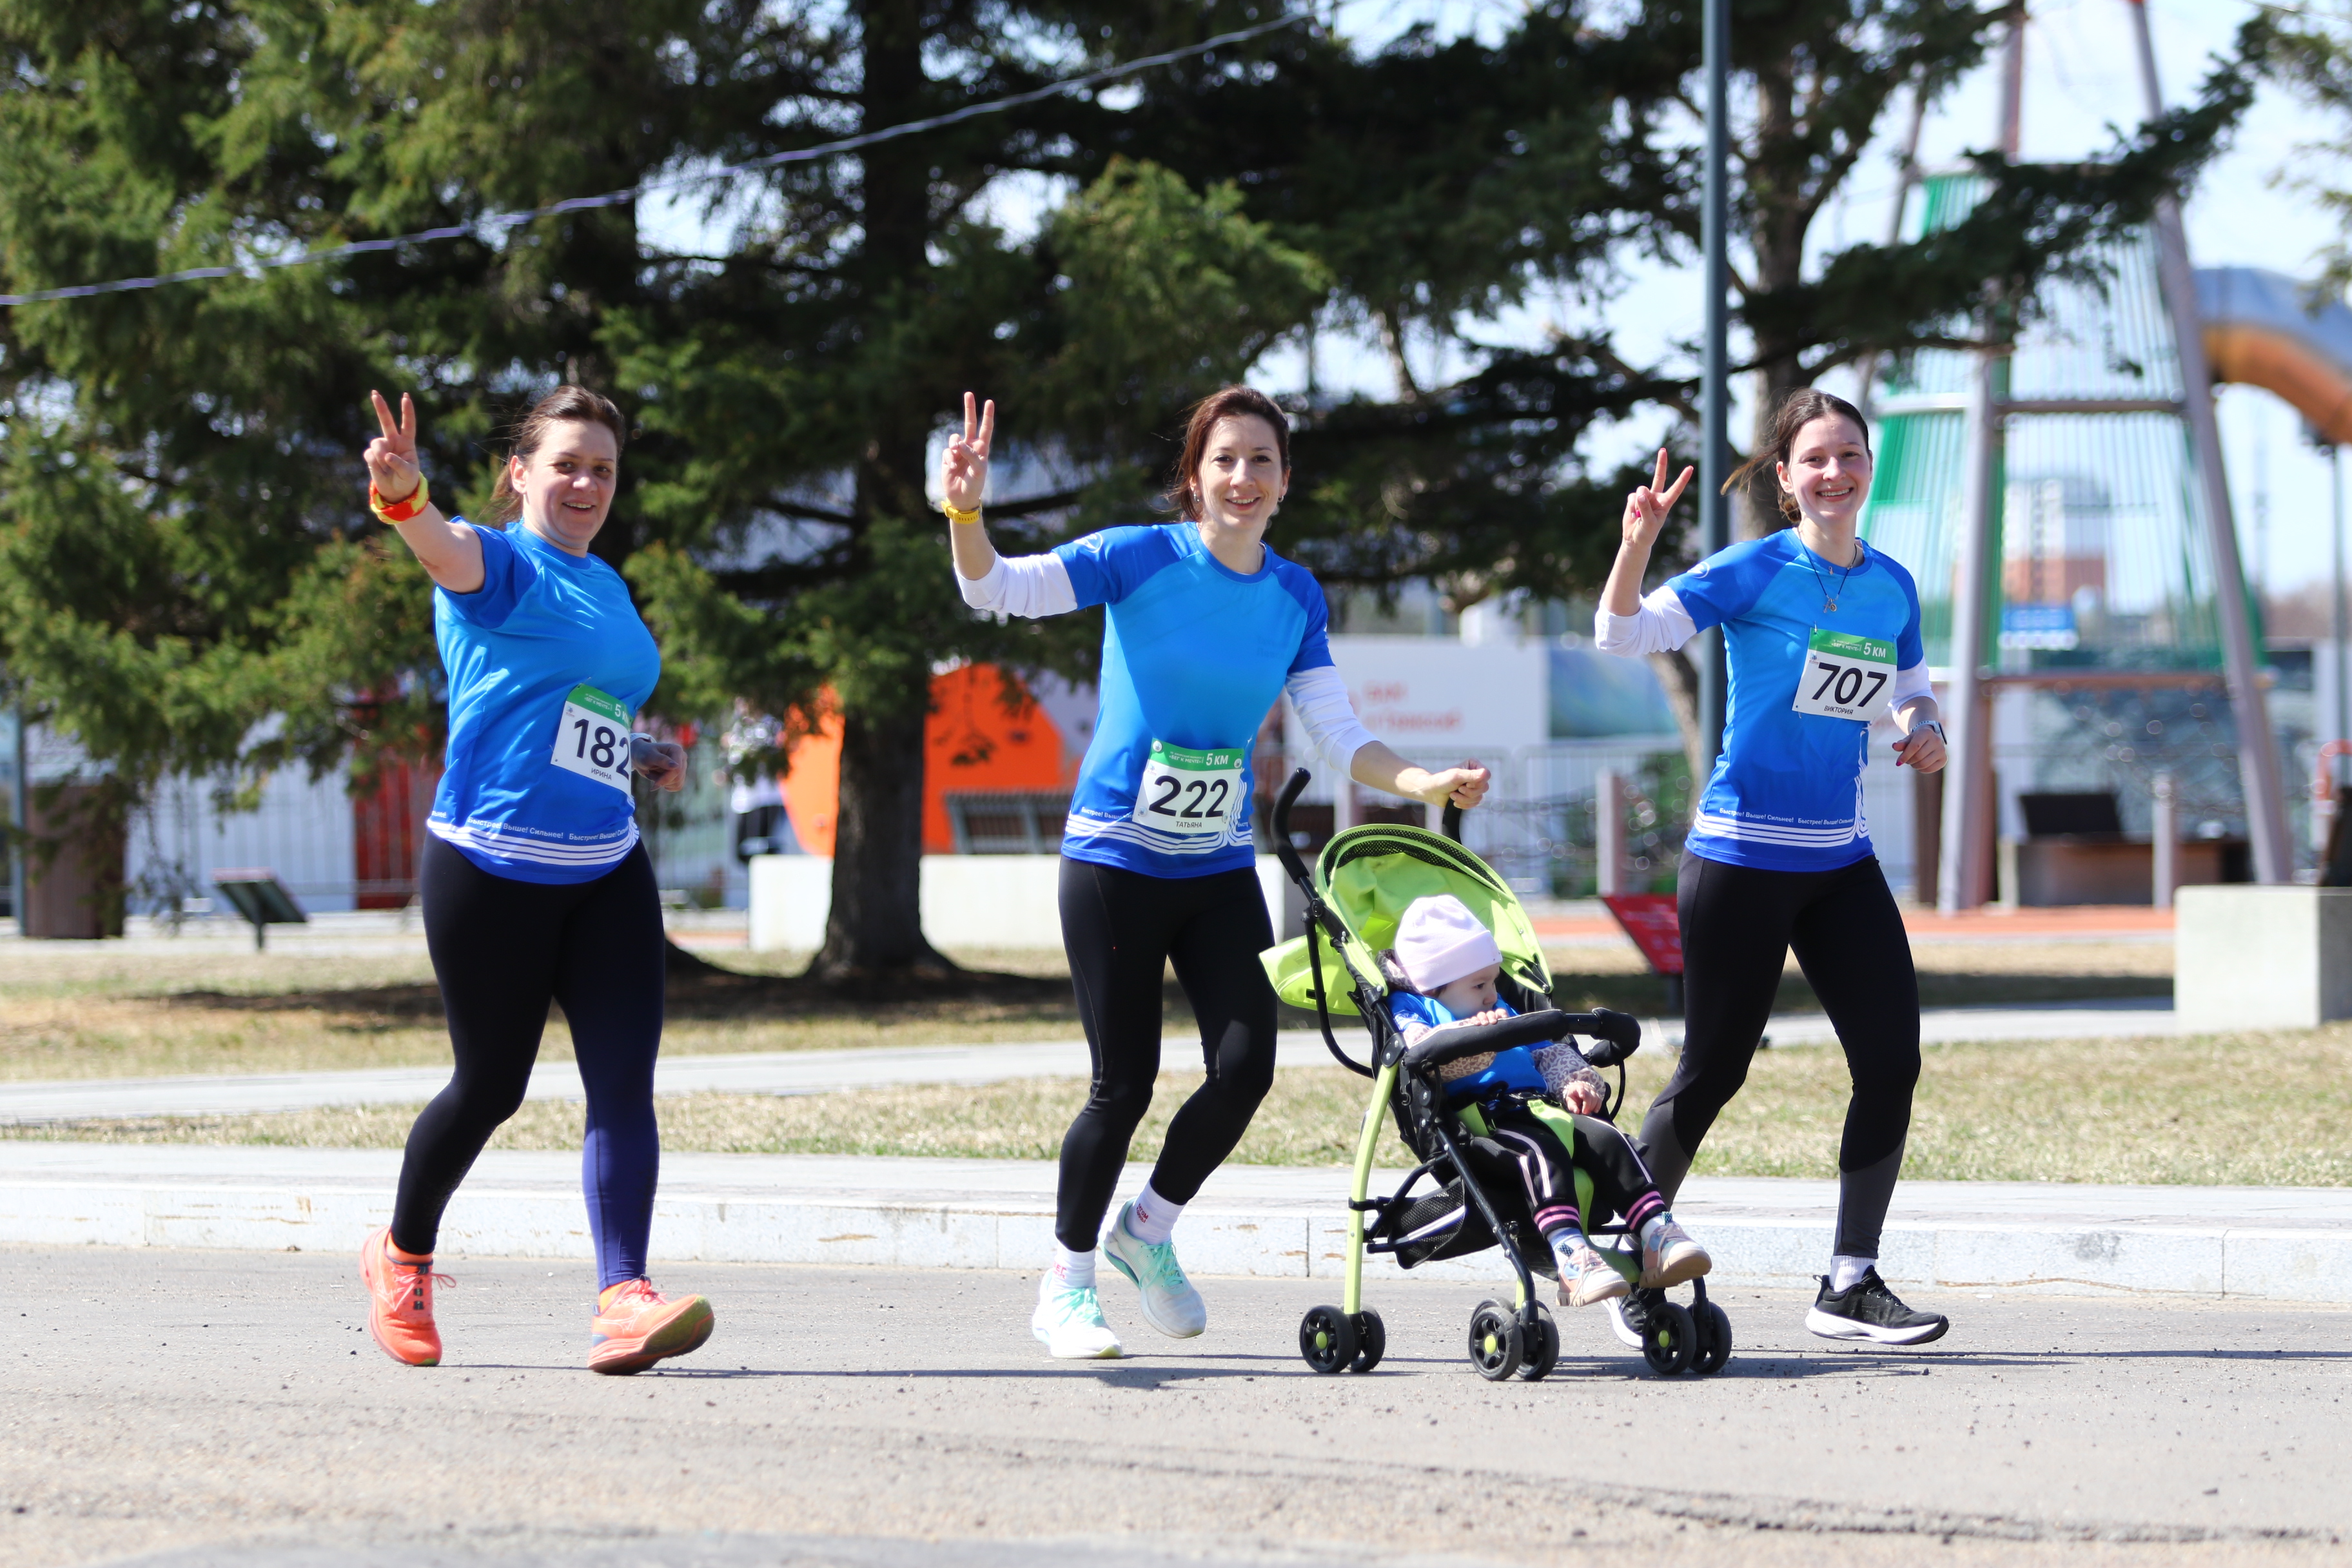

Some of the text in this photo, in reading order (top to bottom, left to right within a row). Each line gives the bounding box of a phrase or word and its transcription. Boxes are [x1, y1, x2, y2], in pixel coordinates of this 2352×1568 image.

[1863, 642, 1872, 656] 5
[1812, 662, 1888, 707] 707
[614, 703, 622, 718] 5
[1824, 705, 1854, 715] ВИКТОРИЯ
[574, 718, 630, 781] 182
[1206, 752, 1213, 766] 5
[591, 767, 612, 781] ИРИНА
[1149, 775, 1229, 818] 222
[1081, 807, 1103, 817] Быстрее!
[1719, 807, 1744, 817] Быстрее!
[1767, 814, 1794, 823] Сильнее!
[467, 817, 503, 829] Быстрее!
[503, 823, 528, 833] Выше!
[529, 827, 564, 839] Сильнее!
[599, 831, 617, 839] Выше!
